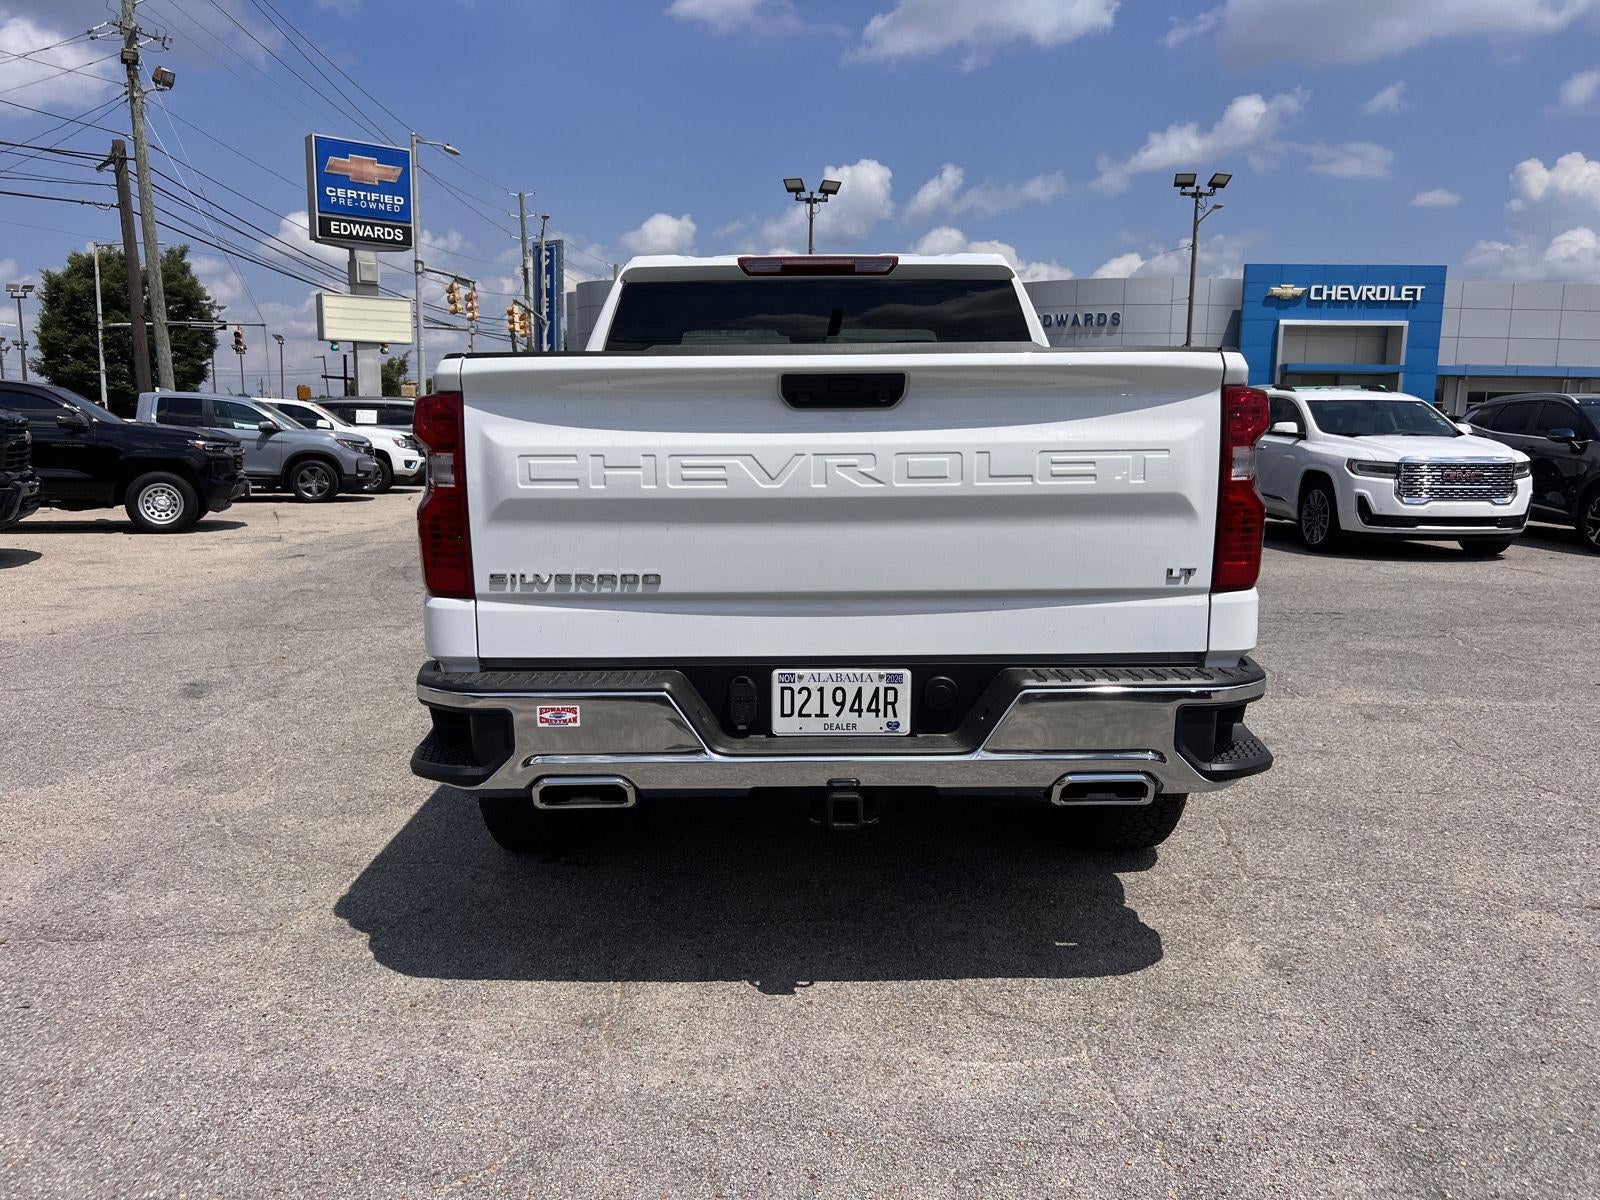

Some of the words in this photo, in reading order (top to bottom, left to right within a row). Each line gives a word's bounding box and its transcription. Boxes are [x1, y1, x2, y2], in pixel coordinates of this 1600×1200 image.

[326, 187, 404, 205] CERTIFIED
[331, 196, 400, 213] PRE-OWNED
[330, 221, 404, 241] EDWARDS
[1310, 285, 1426, 301] CHEVROLET
[1037, 312, 1121, 328] DWARDS
[517, 448, 1170, 489] CHEVROLET
[1442, 471, 1485, 480] GMC
[489, 573, 661, 588] SILVERADO
[1166, 568, 1197, 582] LT
[779, 673, 795, 683] NOV
[807, 672, 874, 683] ALABAMA
[886, 673, 904, 684] 2026
[780, 686, 899, 718] D21944R
[823, 722, 858, 731] DEALER
